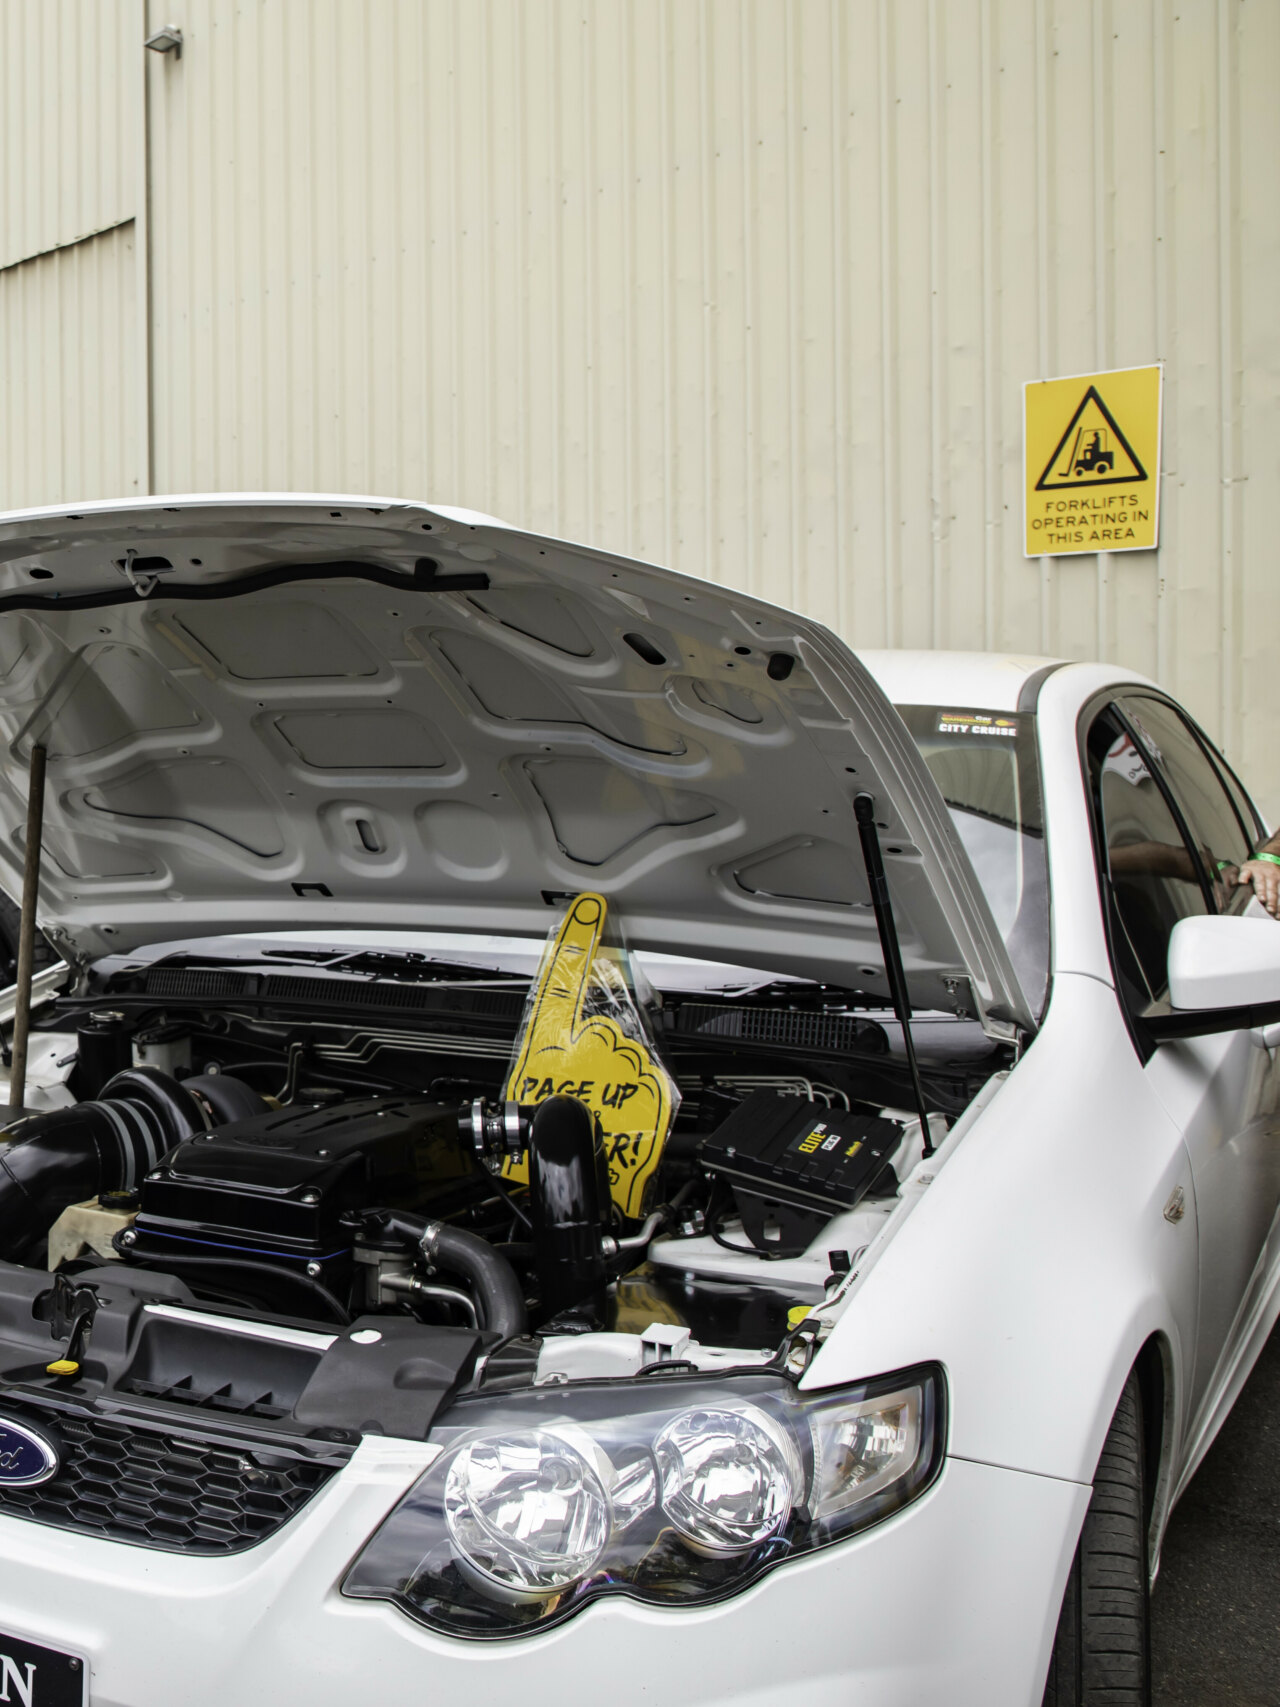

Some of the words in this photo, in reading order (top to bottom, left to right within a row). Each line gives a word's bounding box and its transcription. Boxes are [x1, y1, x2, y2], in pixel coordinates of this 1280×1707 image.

[1045, 494, 1139, 513] FORKLIFTS
[1031, 511, 1128, 530] OPERATING
[1132, 509, 1150, 522] IN
[1047, 530, 1084, 545] THIS
[1089, 527, 1136, 541] AREA
[938, 723, 970, 734] CITY
[971, 725, 1017, 737] CRUISE
[601, 1082, 639, 1110] UP
[798, 1131, 827, 1153] ELITE
